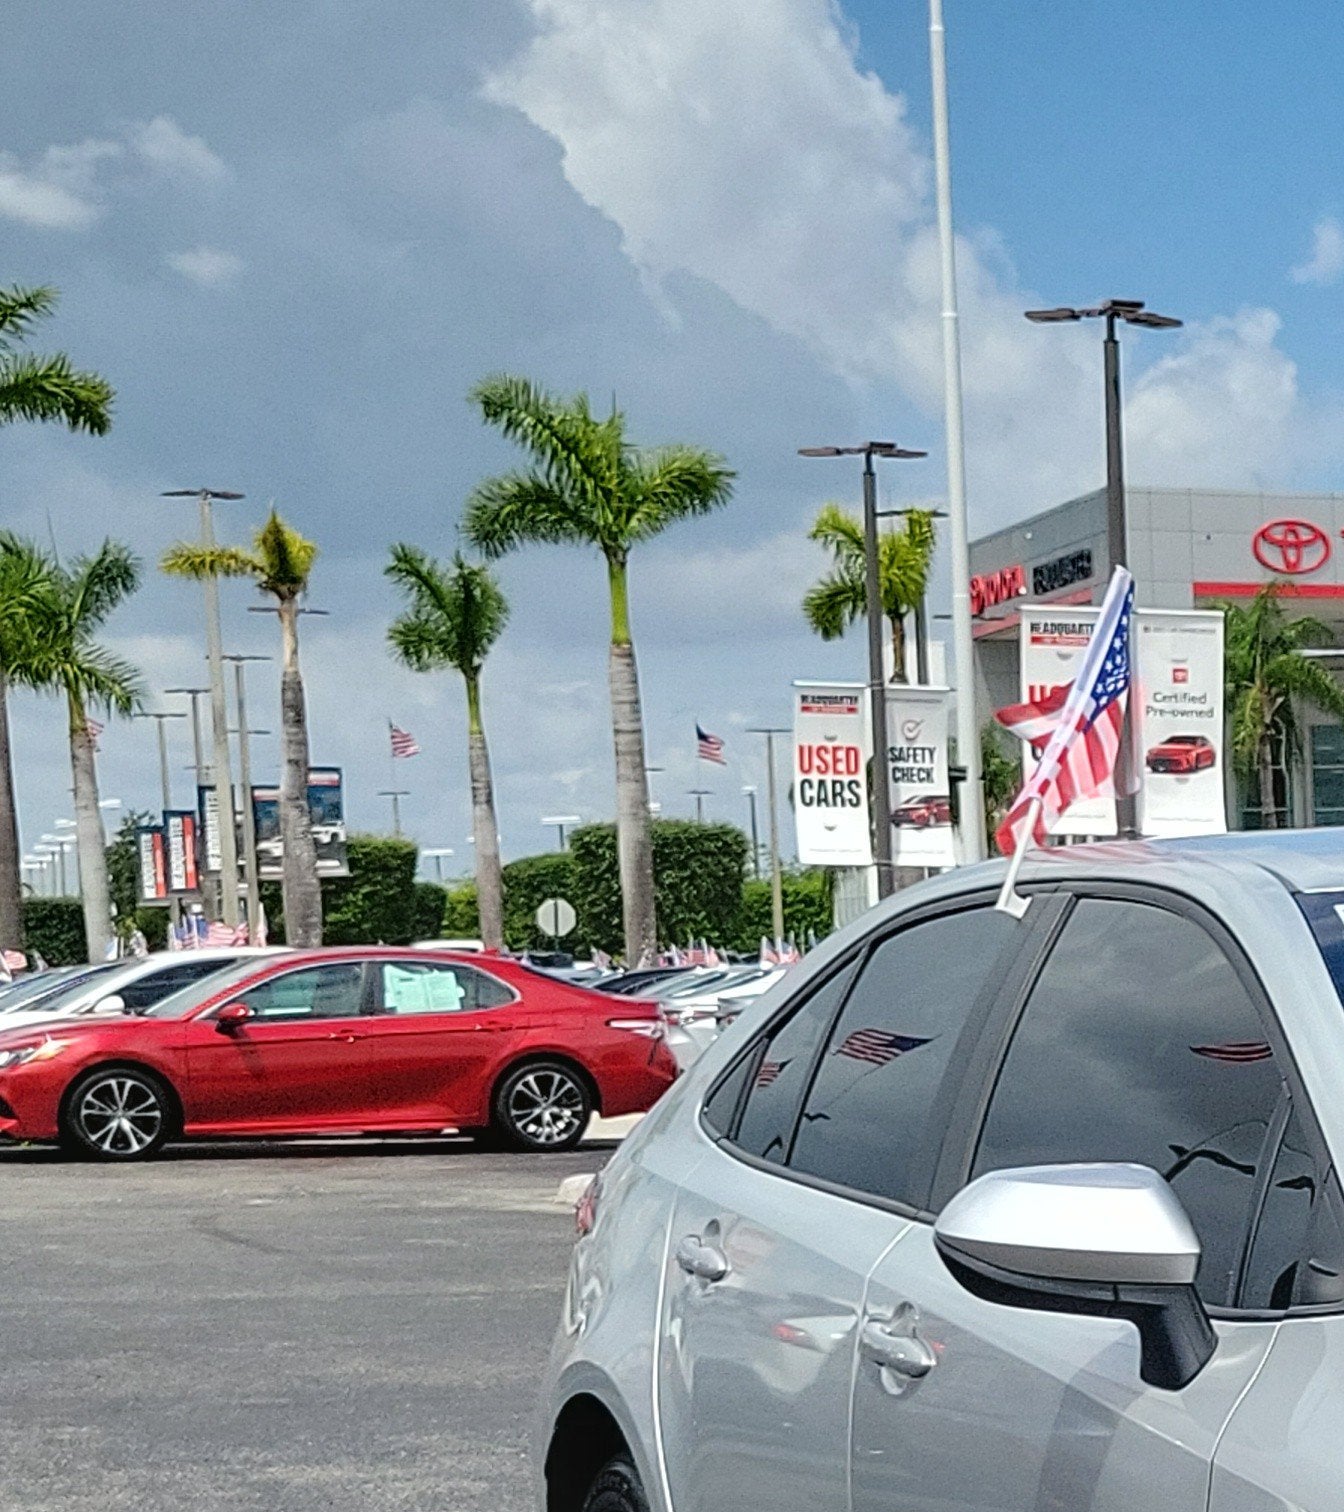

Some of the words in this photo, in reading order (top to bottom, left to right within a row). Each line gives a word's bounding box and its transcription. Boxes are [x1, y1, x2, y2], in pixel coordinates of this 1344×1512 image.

[1153, 692, 1207, 704] Certified
[1145, 705, 1214, 718] Pre-owned
[799, 745, 860, 776] USED
[889, 747, 936, 764] SAFETY
[892, 766, 935, 784] CHECK
[800, 779, 862, 808] CARS
